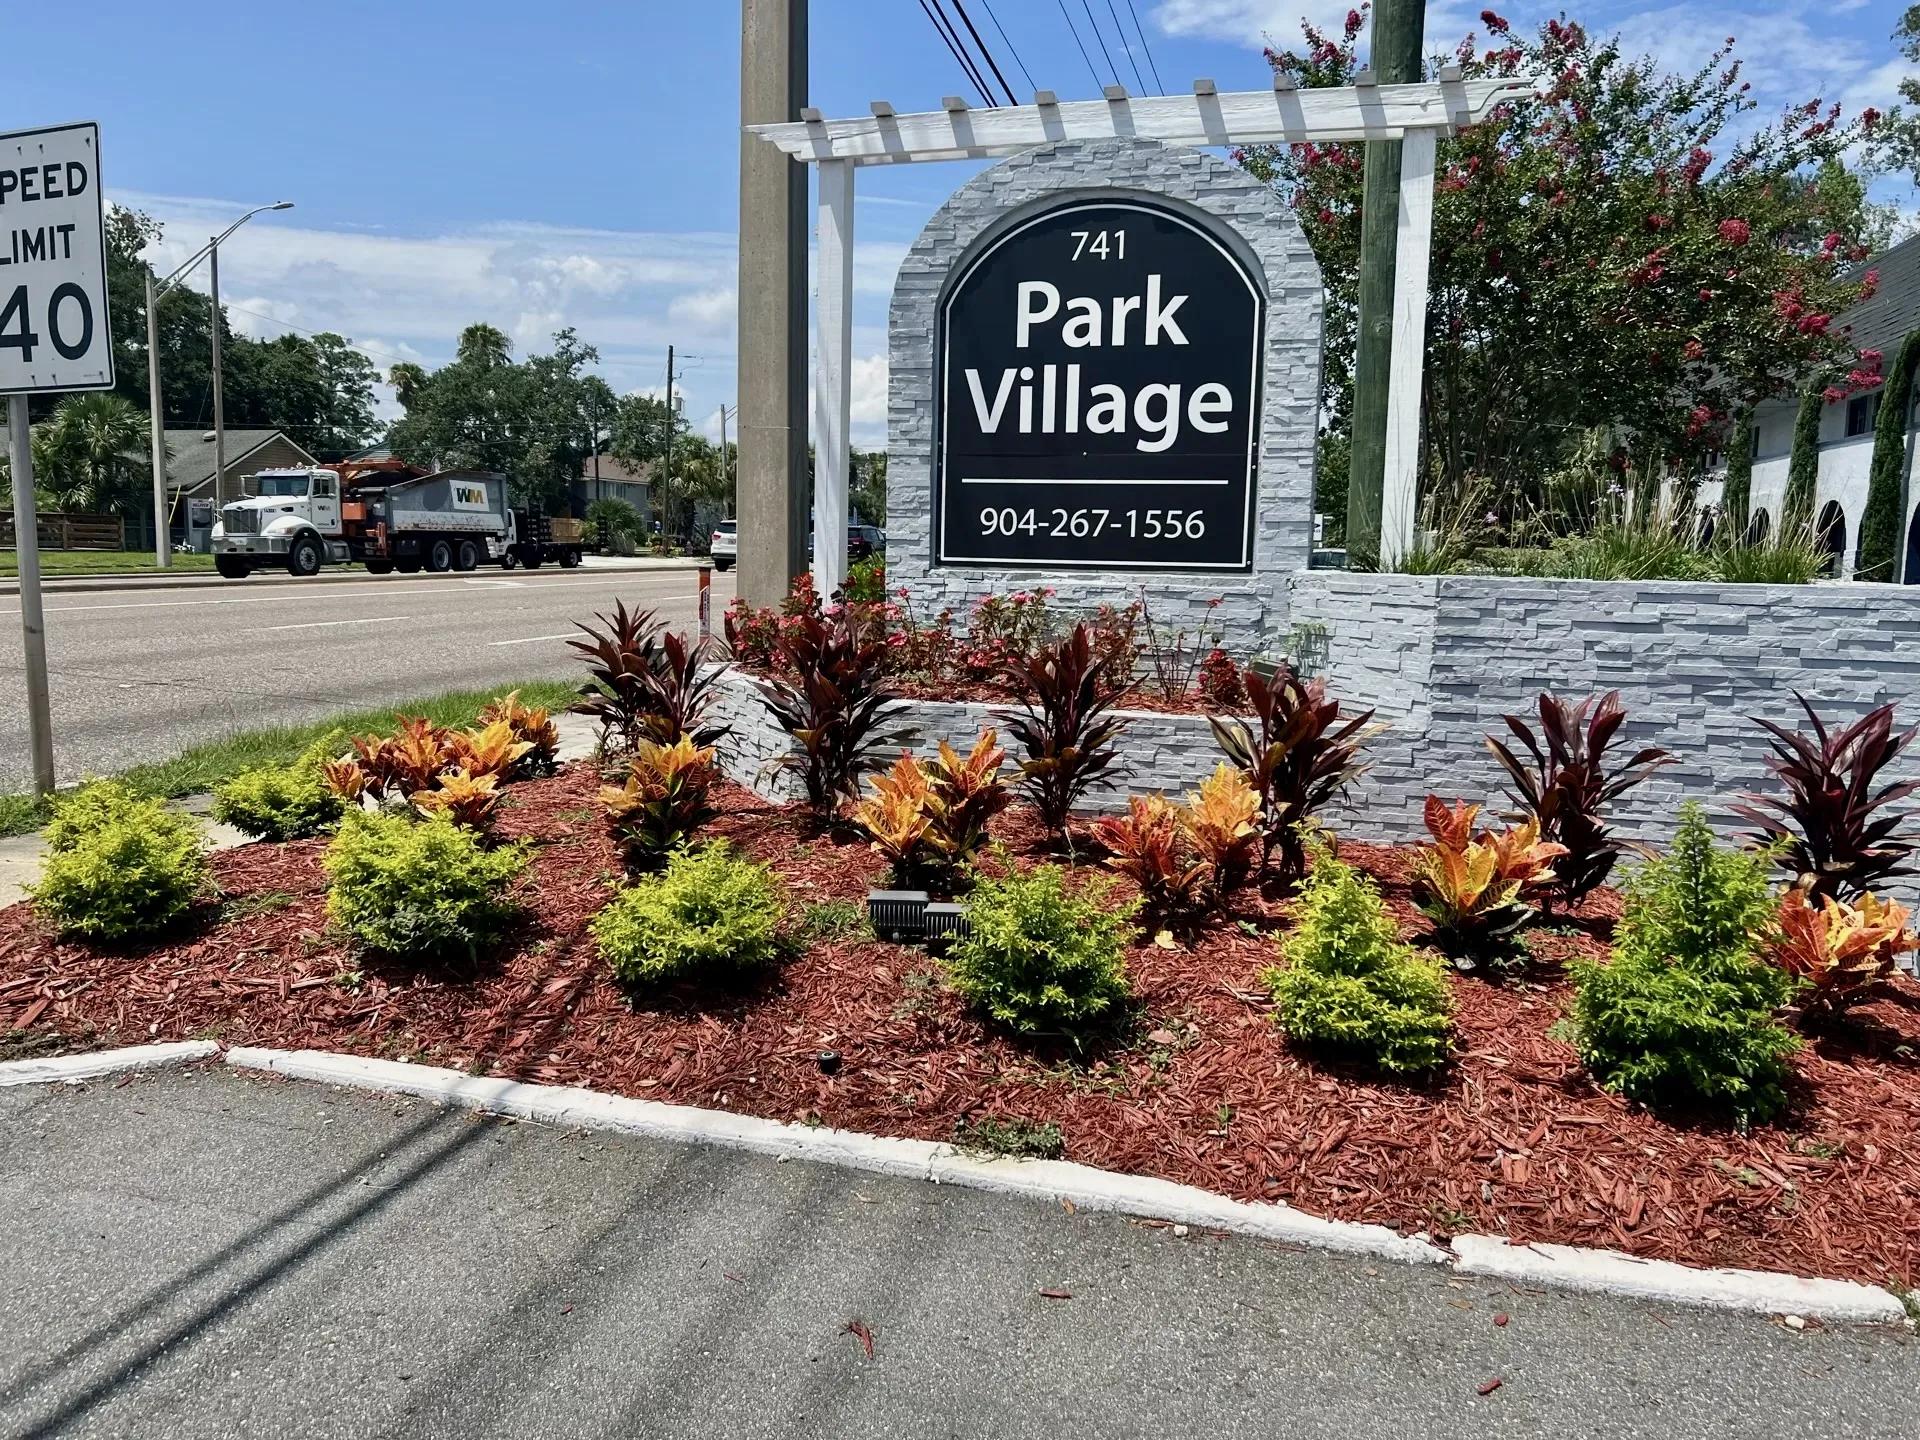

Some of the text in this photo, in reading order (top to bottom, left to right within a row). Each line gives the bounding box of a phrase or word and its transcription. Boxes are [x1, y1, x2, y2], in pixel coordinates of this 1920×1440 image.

[1070, 229, 1126, 261] 741
[0, 282, 94, 363] 40
[1016, 273, 1190, 348] Park
[964, 363, 1233, 453] Village
[455, 487, 484, 504] WM
[979, 507, 1205, 539] 904-267-1556
